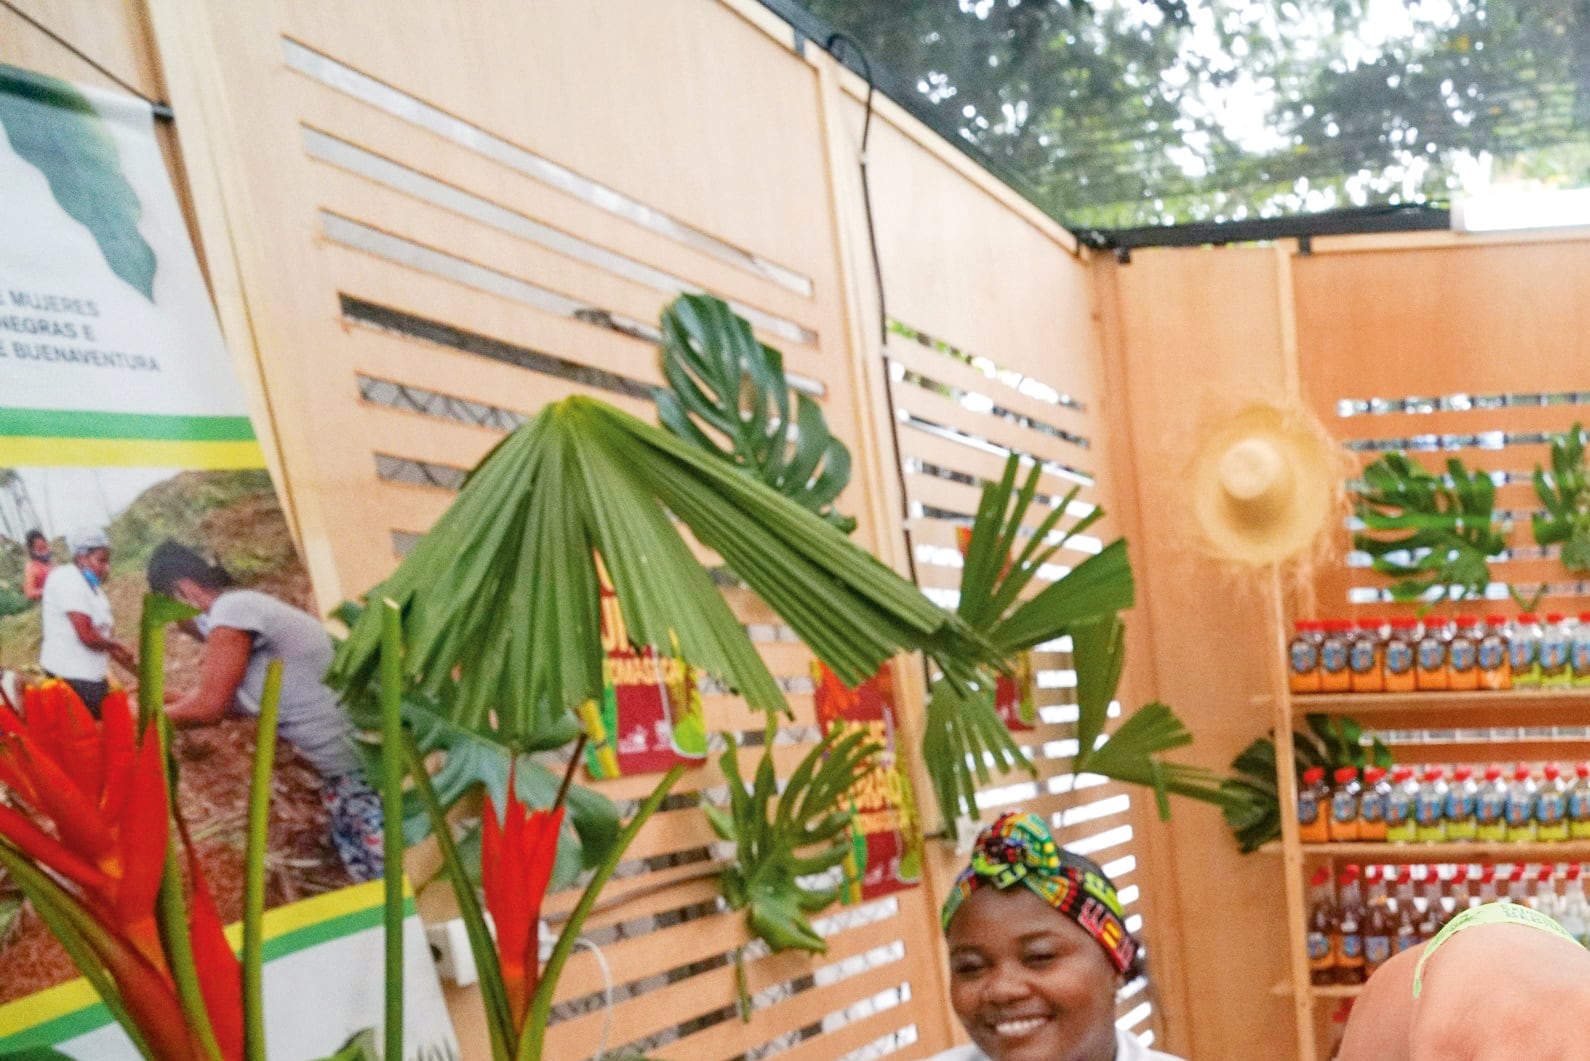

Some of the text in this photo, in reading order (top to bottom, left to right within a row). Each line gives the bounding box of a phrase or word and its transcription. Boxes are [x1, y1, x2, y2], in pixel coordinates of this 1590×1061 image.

[9, 290, 99, 317] MUJERES
[82, 323, 95, 342] E
[12, 341, 161, 371] BUENAVENTURA
